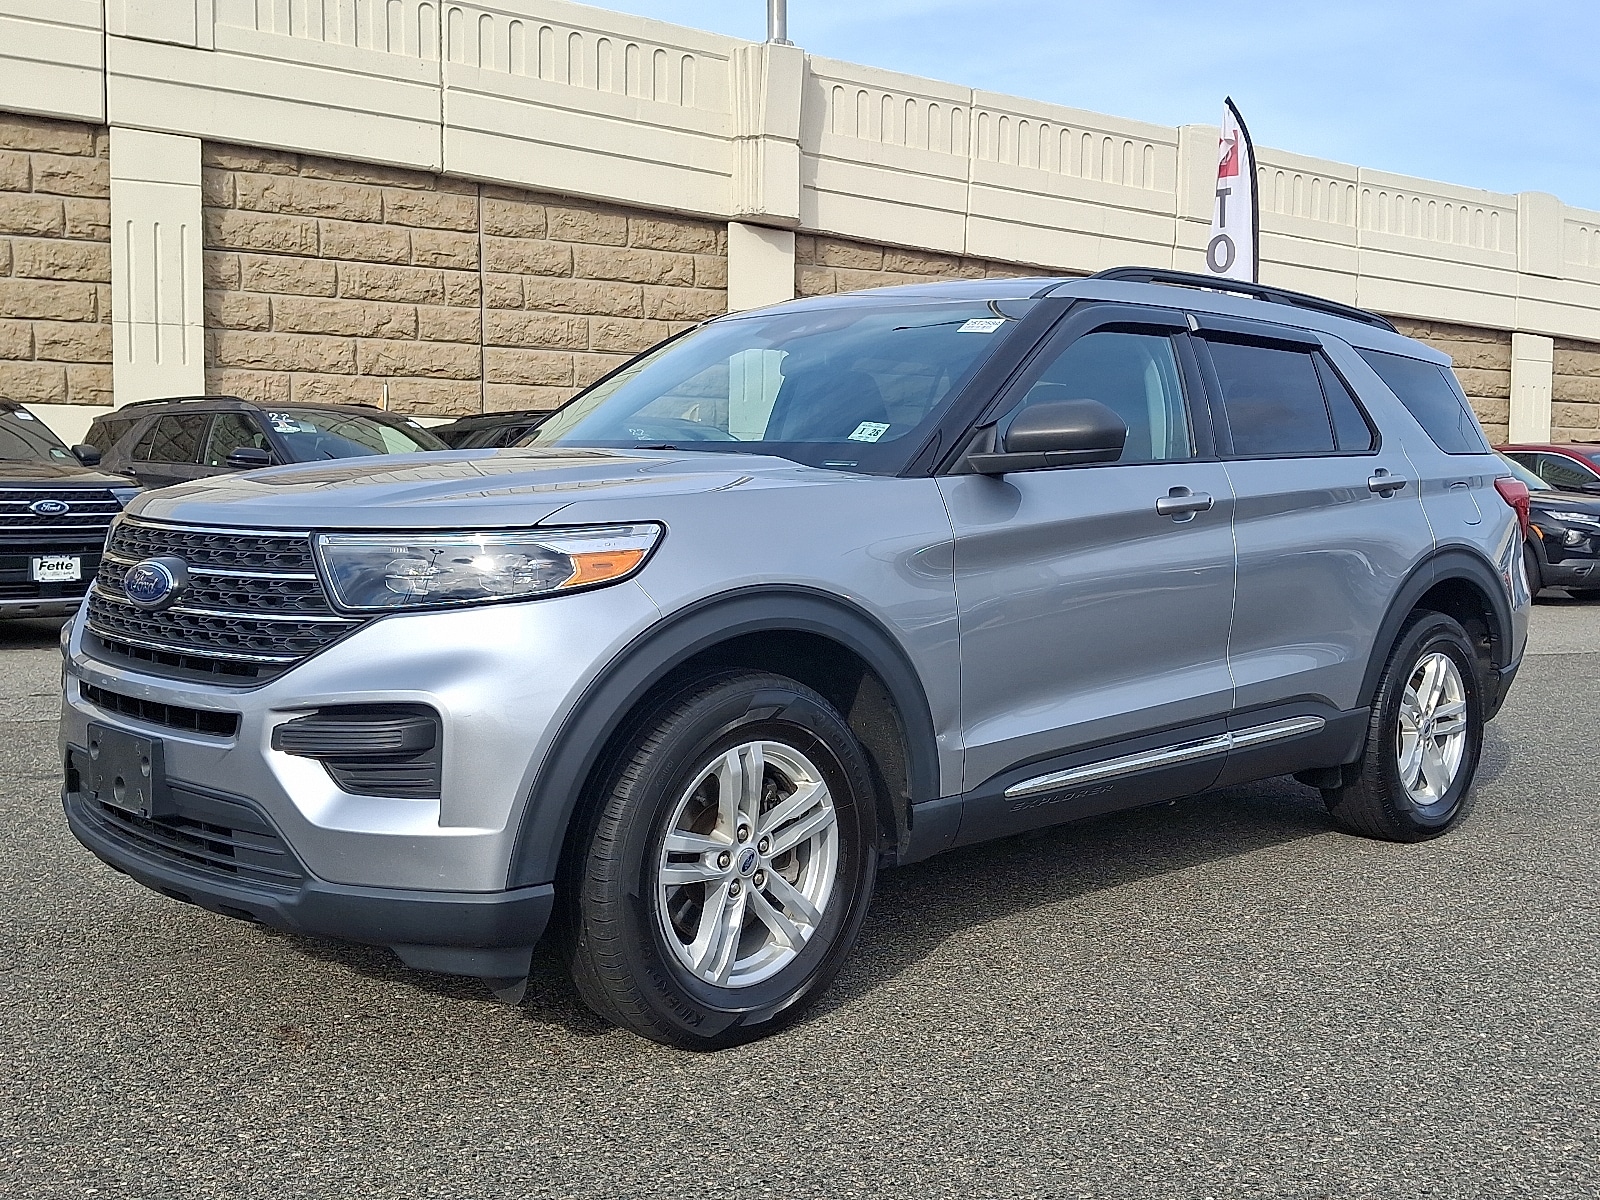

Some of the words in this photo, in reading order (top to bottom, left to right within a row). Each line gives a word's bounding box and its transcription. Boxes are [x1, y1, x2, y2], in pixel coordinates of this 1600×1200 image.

[40, 502, 62, 512] Ford
[38, 561, 74, 571] Fette
[130, 569, 159, 595] Ford
